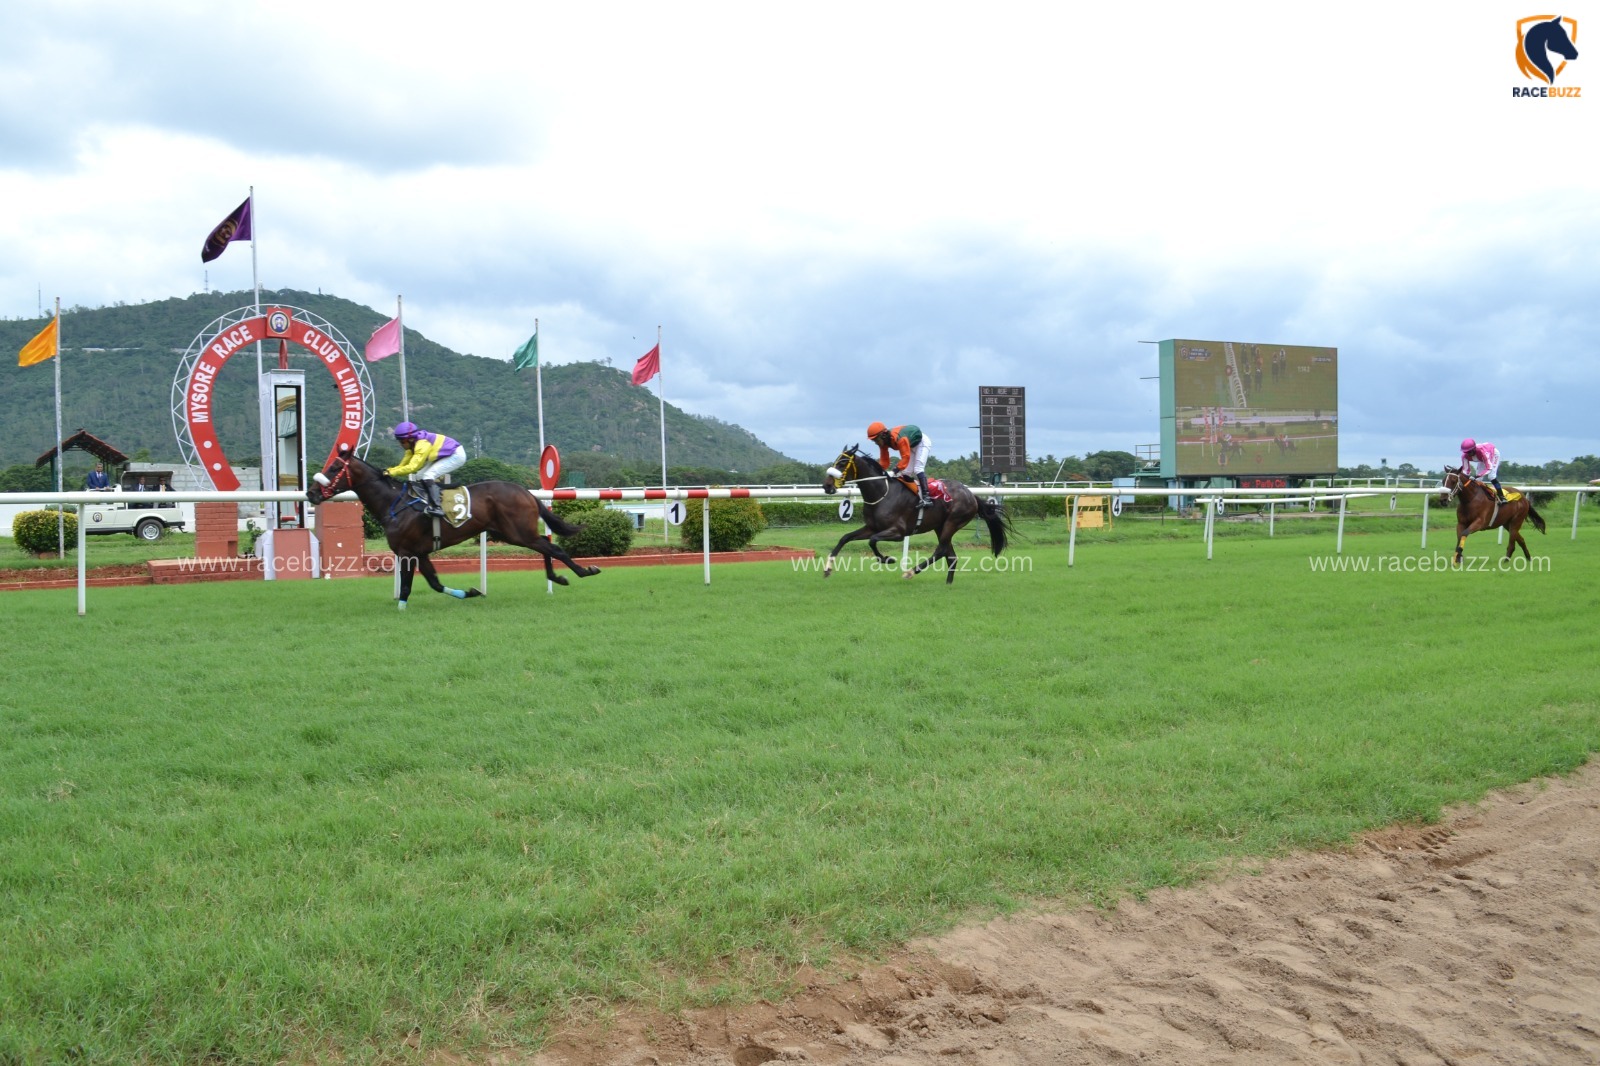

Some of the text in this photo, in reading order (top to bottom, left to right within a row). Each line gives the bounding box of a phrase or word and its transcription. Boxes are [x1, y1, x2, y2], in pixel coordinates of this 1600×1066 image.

[192, 324, 361, 430] MYSORE RACE CLUB LIMITED
[453, 503, 467, 521] 2
[671, 503, 679, 523] 1
[842, 500, 850, 518] 2
[1114, 498, 1120, 514] 4
